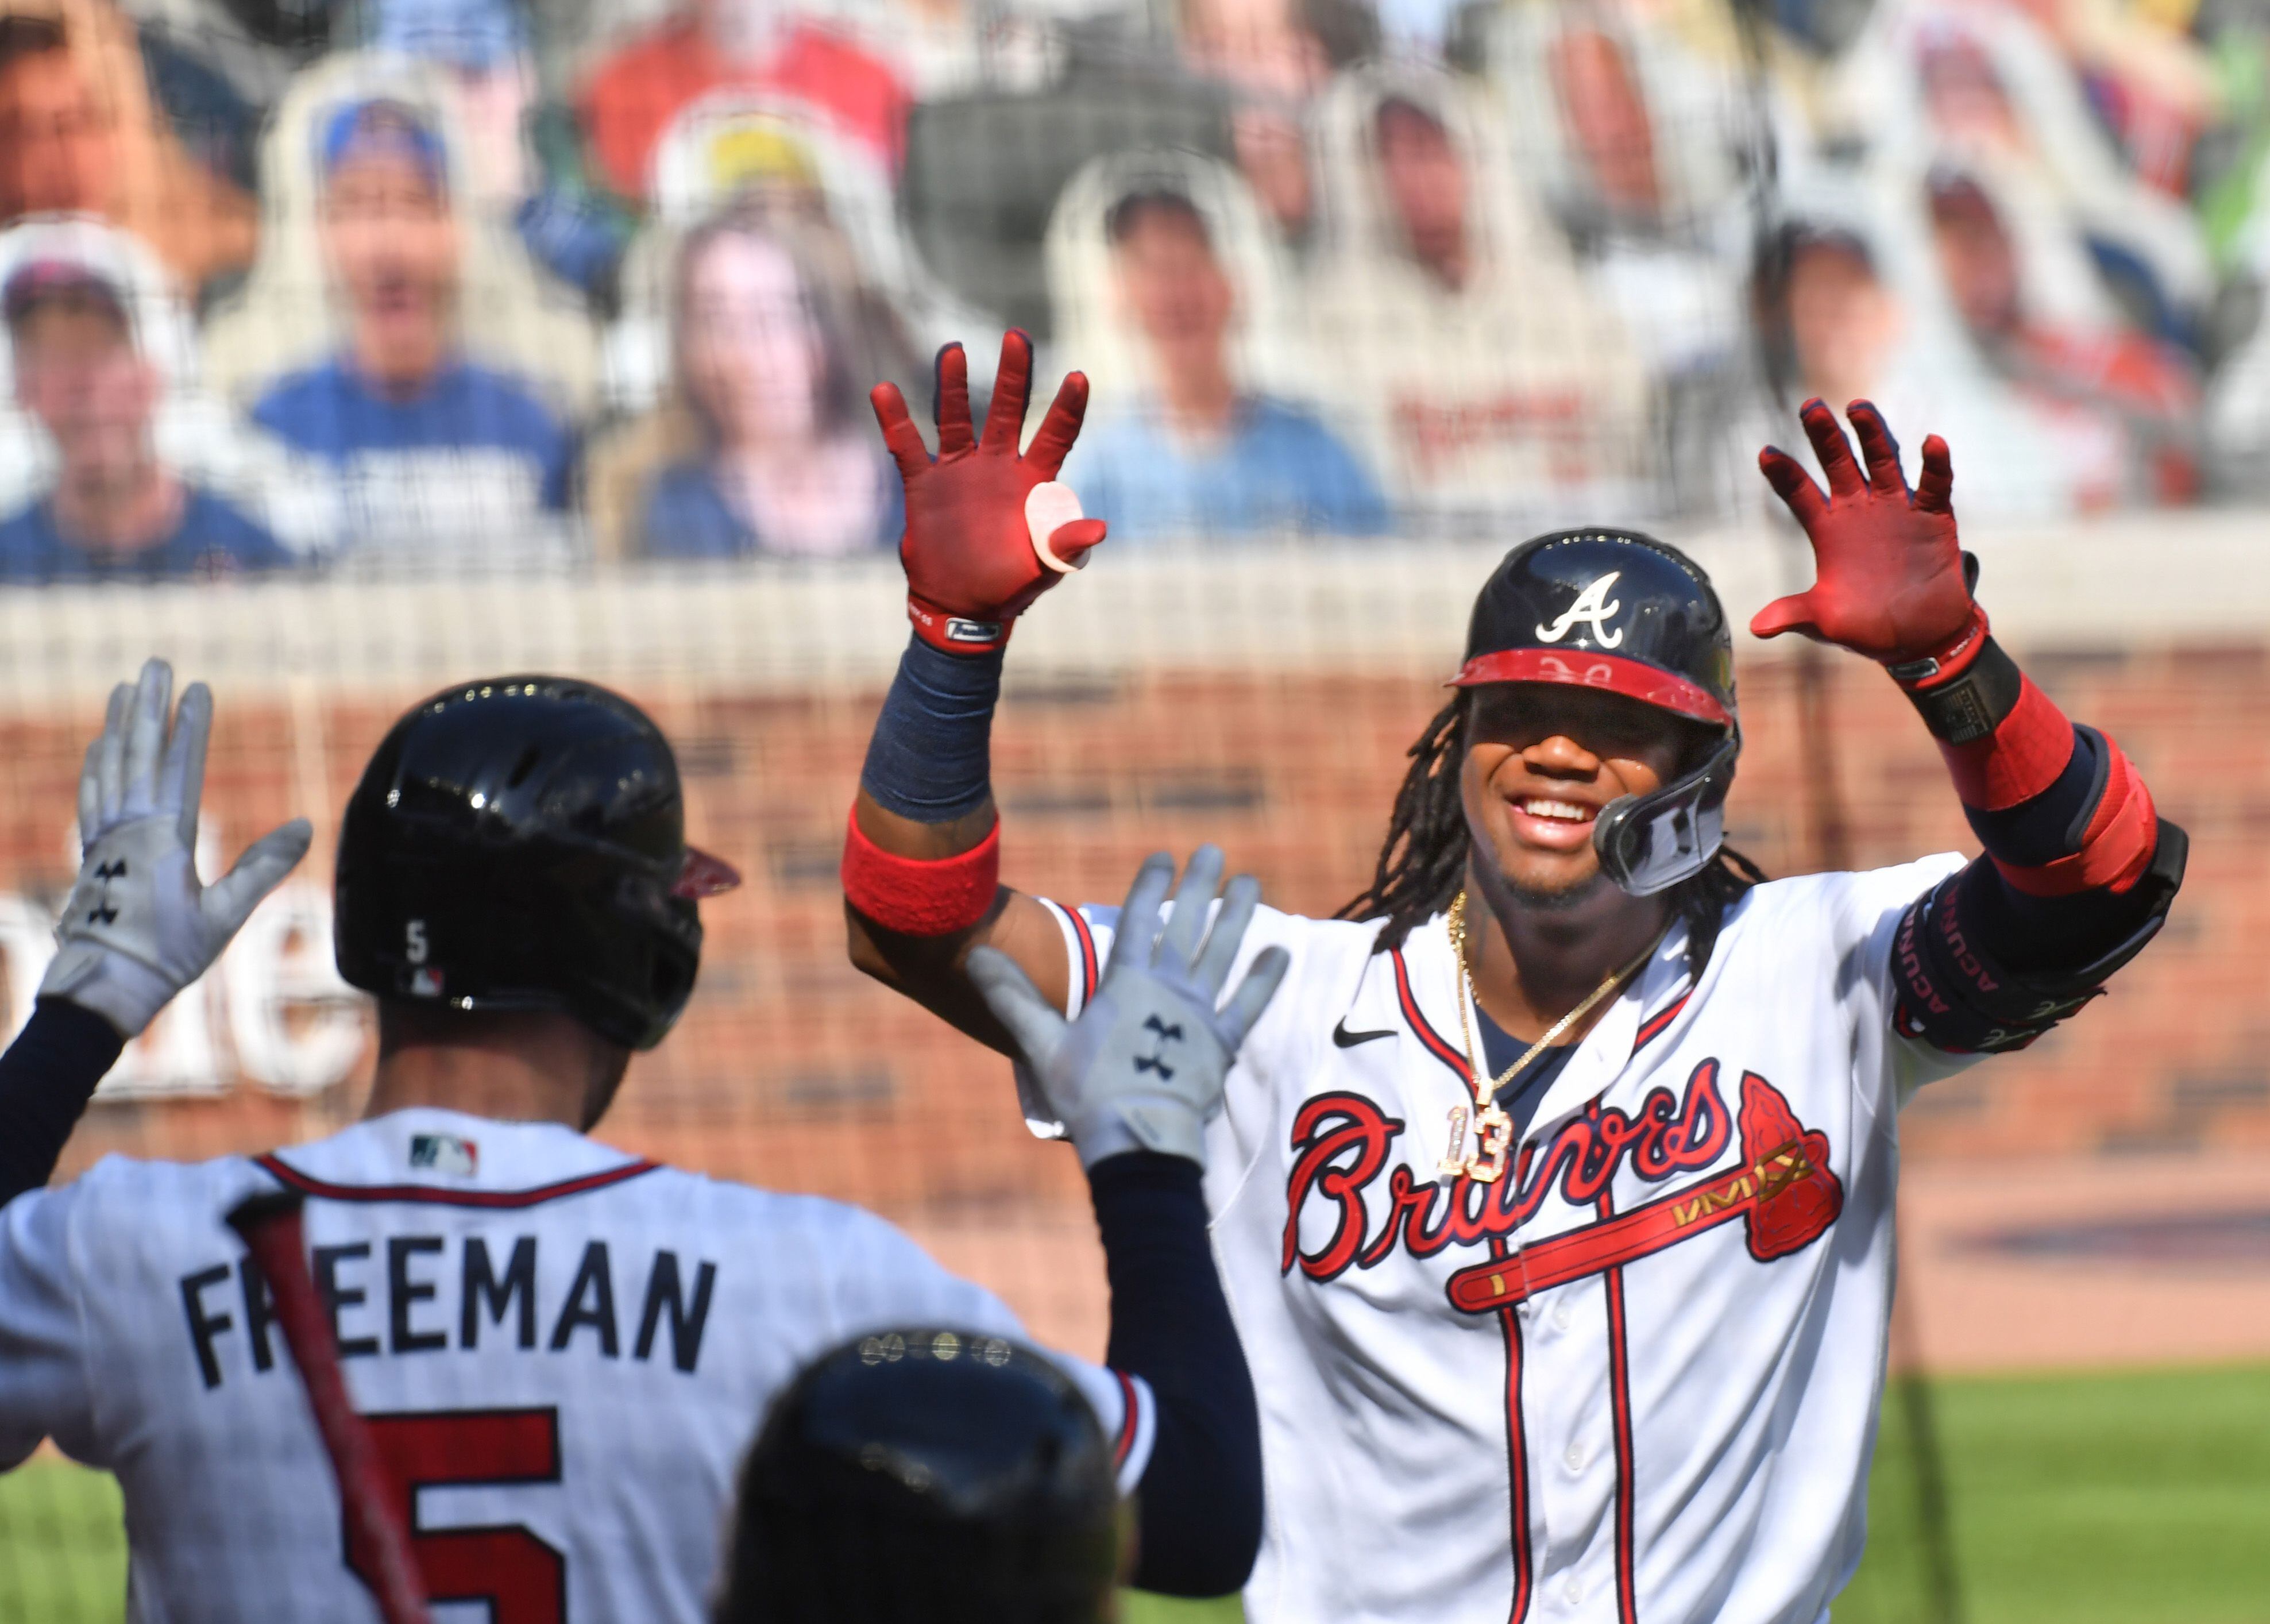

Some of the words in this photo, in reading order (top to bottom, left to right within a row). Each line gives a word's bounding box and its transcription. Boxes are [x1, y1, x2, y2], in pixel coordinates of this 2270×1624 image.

[1535, 572, 1623, 649] A
[406, 920, 427, 963] 5
[1283, 1056, 1731, 1282] Braves
[1437, 1105, 1514, 1182] 13
[342, 1405, 568, 1624] 5
